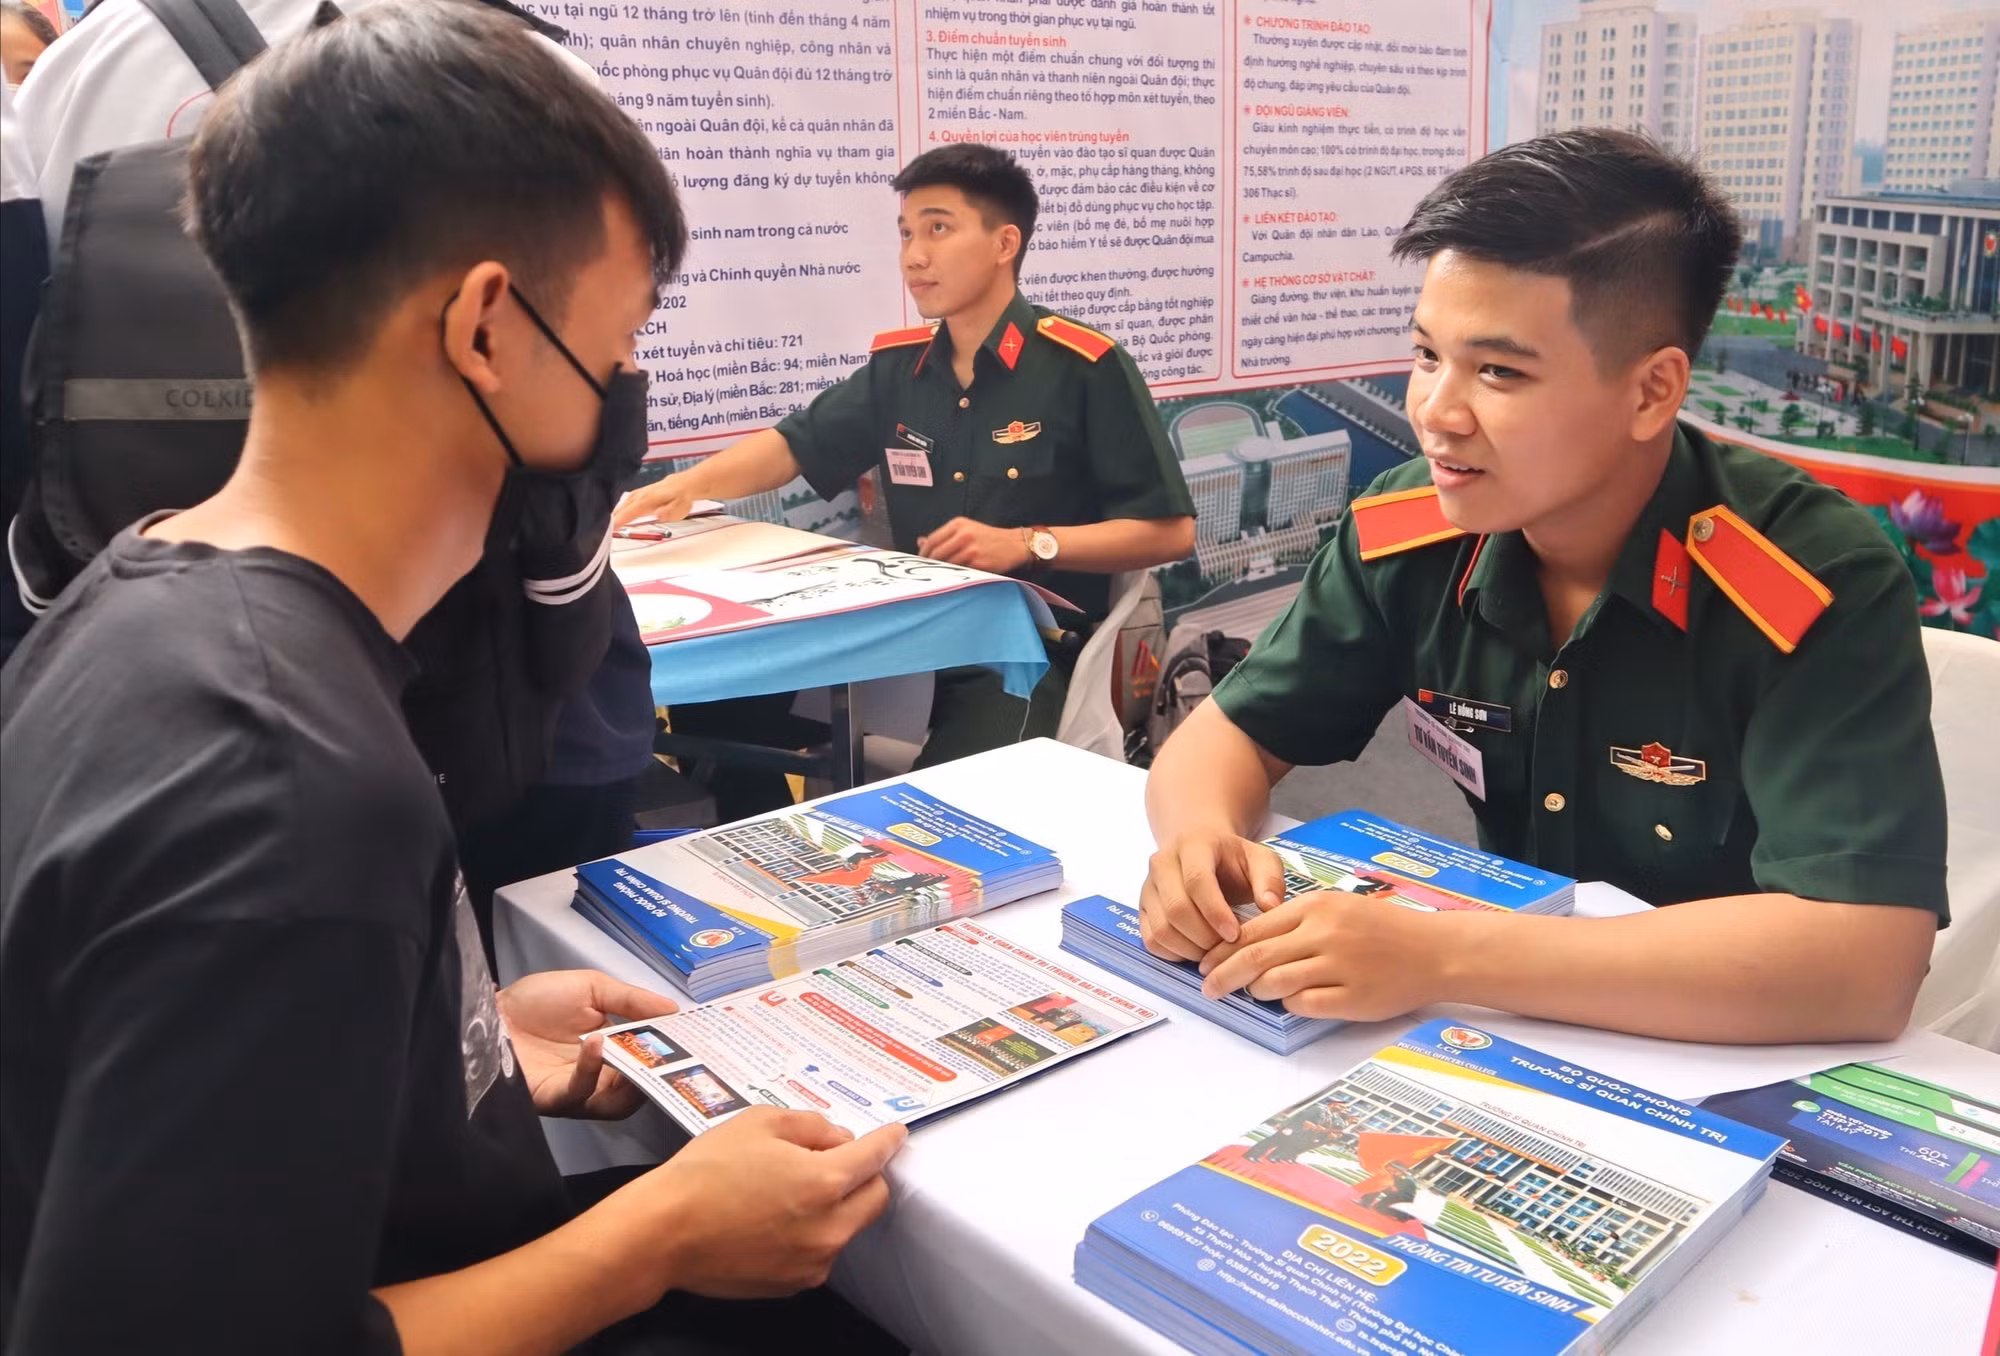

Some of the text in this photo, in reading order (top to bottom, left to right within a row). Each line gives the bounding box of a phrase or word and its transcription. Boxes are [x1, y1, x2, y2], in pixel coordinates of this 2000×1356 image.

[539, 3, 890, 29] vụ tại ngũ 12 tháng trở lên (tính đến tháng 4 năm
[600, 34, 891, 57] quân nhân chuyên nghiệp, công nhân và
[656, 116, 894, 136] ngoài Quân đội, kể cả quân nhân đã
[691, 221, 848, 240] sinh nam trong cả nước
[691, 261, 861, 283] và Chính quyền Nhà nước
[642, 334, 803, 360] xét tuyển và chỉ tiêu: 721
[1397, 1041, 1498, 1077] POLITICAL OFFICERS COLLEGE
[1509, 1054, 1729, 1145] TRƯỜNG SĨ QUAN CHÍNH TRỊ
[1560, 1064, 1692, 1118] BỘ QUỐC PHÒNG
[1820, 1111, 1889, 1140] THPT 2017
[1311, 1232, 1388, 1277] 2022
[1282, 1248, 1379, 1303] ĐỊA CHỈ LIÊN HỆ:
[1388, 1235, 1579, 1313] THÔNG TIN TUYỂN SINH
